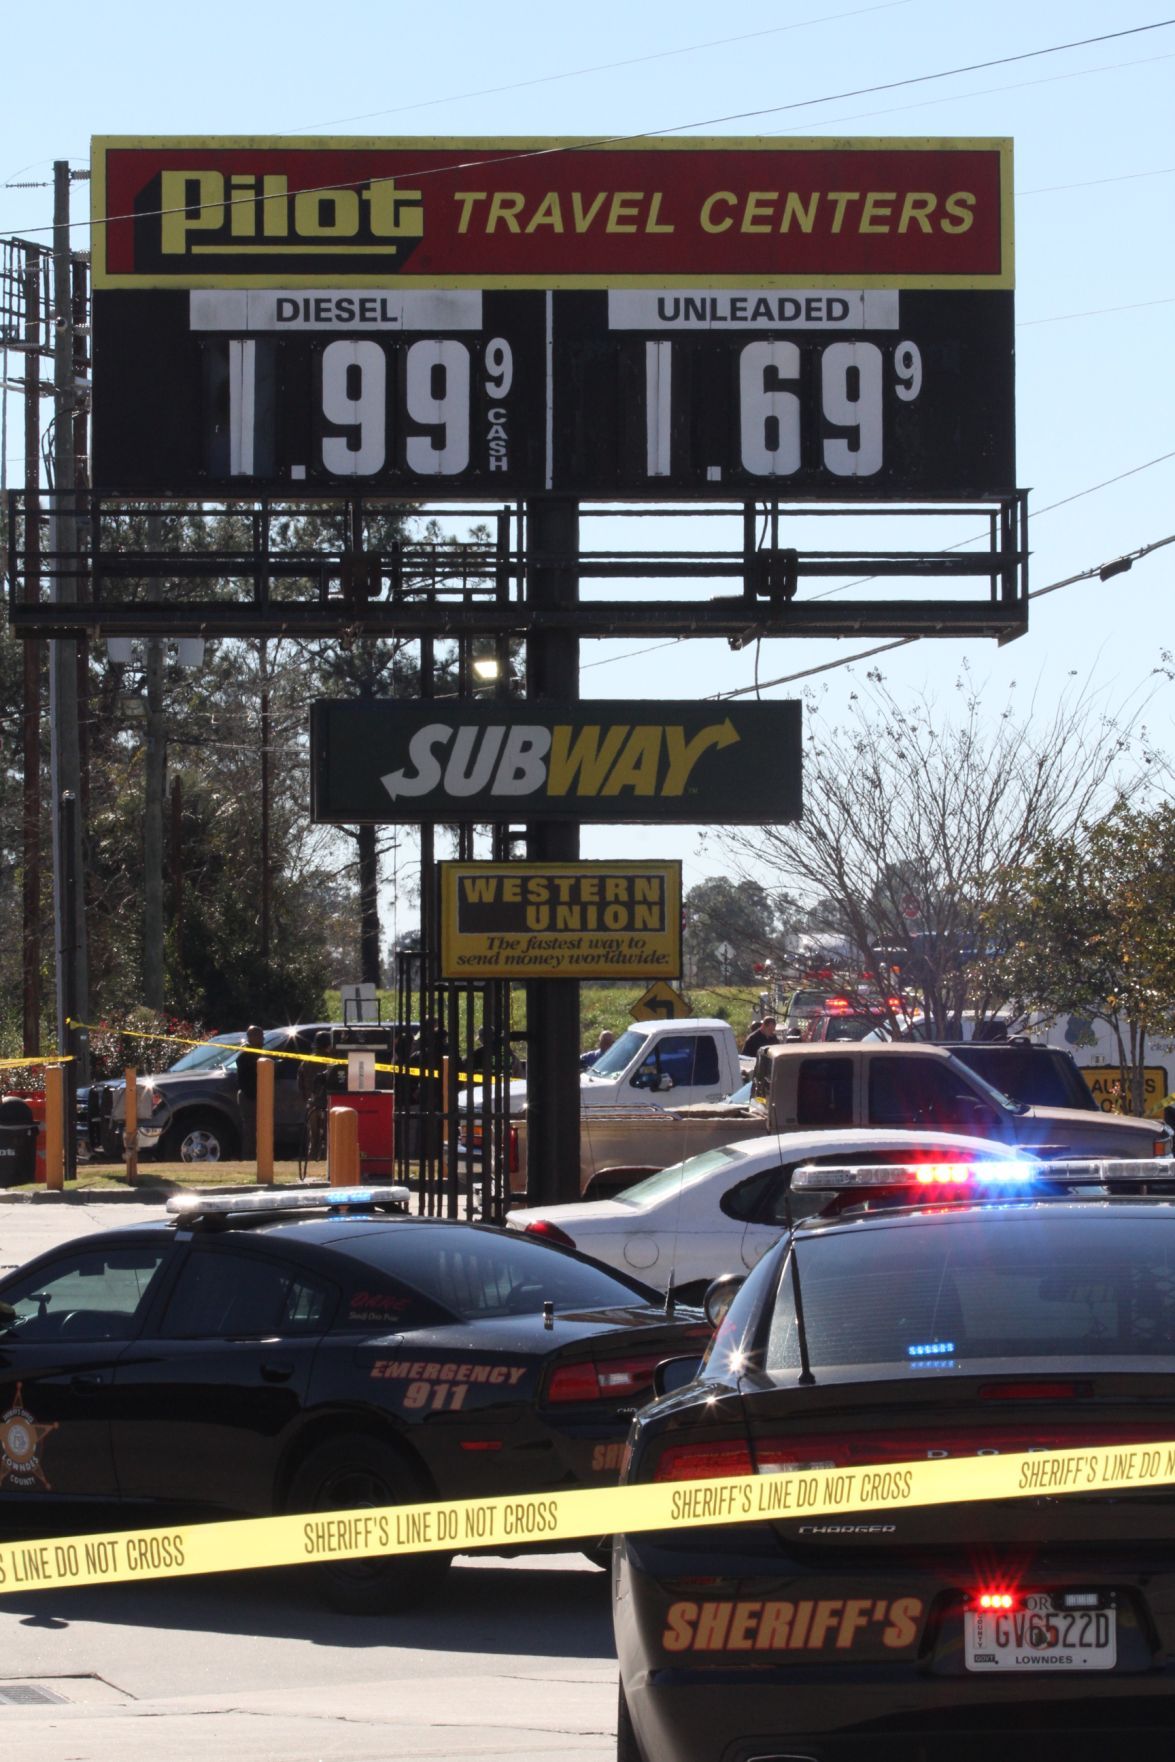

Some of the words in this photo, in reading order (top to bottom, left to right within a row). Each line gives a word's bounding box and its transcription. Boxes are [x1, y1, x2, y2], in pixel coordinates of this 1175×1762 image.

[161, 170, 424, 254] Pilot
[454, 191, 677, 234] TRAVEL
[700, 191, 977, 234] CENTERS
[275, 297, 399, 323] DIESEL
[657, 297, 850, 322] UNLEADED
[486, 407, 509, 472] CASH
[380, 717, 741, 802] SUBWAY
[463, 877, 661, 903] WESTERN
[526, 904, 661, 930] UNION
[487, 936, 519, 951] The
[524, 936, 583, 954] fastest
[588, 938, 624, 955] way
[628, 936, 646, 950] to
[456, 951, 500, 967] send
[504, 952, 565, 969] money
[1092, 1078, 1157, 1095] AUS
[370, 1360, 528, 1385] EMERGENCY
[402, 1381, 470, 1411] 911
[1018, 1455, 1098, 1490] SHERIFF'S
[1102, 1452, 1138, 1482] LINE
[1139, 1451, 1161, 1479] DO
[671, 1484, 753, 1520] SHERIFF'S
[758, 1479, 793, 1512] LINE
[796, 1477, 819, 1508] DO
[823, 1475, 856, 1506] NOT
[859, 1470, 913, 1503] CROSS
[303, 1515, 390, 1555] SHERIFF'S
[396, 1511, 432, 1545] LINE
[437, 1509, 459, 1541] DO
[464, 1506, 498, 1539] NOT
[503, 1500, 558, 1536] CROSS
[798, 1525, 897, 1534] CHARGER
[12, 1547, 53, 1582] LINE
[54, 1544, 80, 1578] DO
[84, 1540, 119, 1575] NOT
[126, 1534, 186, 1571] CROSS
[661, 1596, 923, 1652] SHERIFF'S
[995, 1612, 1110, 1649] GV6522D
[1015, 1655, 1073, 1665] LOWNDES
